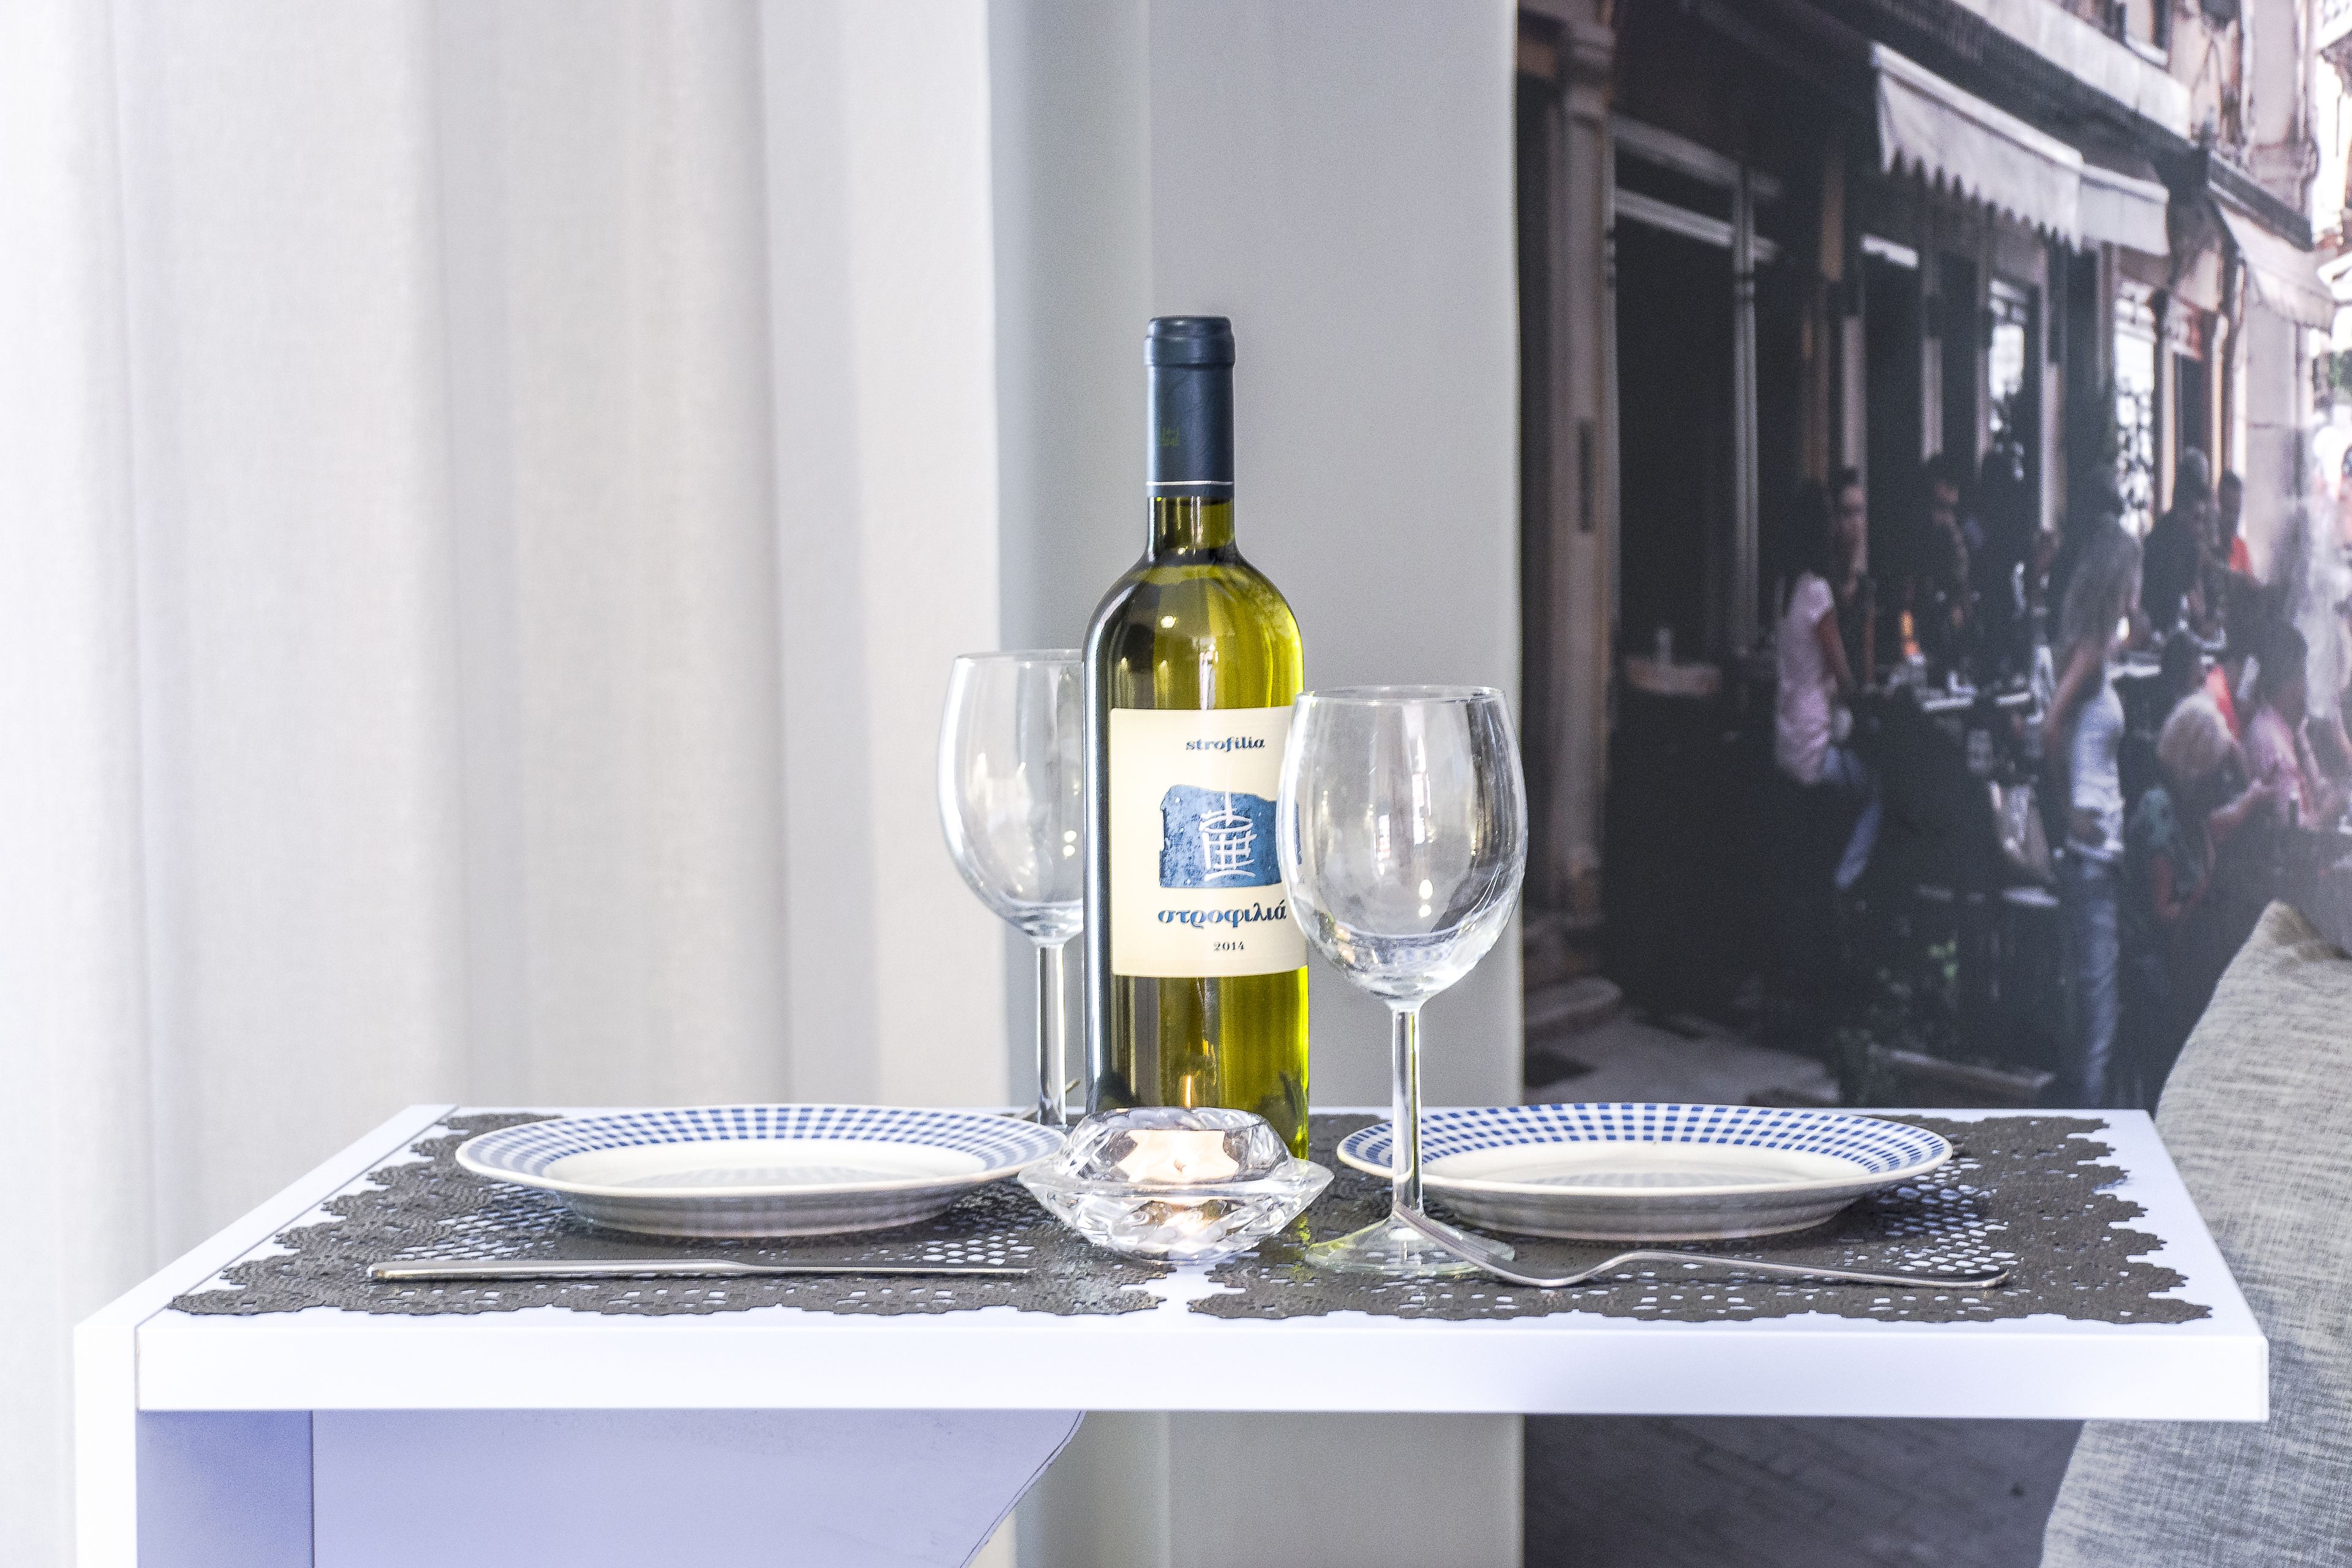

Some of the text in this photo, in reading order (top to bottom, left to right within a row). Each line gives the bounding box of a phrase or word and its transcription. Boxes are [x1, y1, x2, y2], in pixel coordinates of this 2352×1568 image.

[1186, 736, 1265, 752] strofilia
[1158, 899, 1287, 929] στροφιλιά
[1213, 941, 1245, 951] 2014
